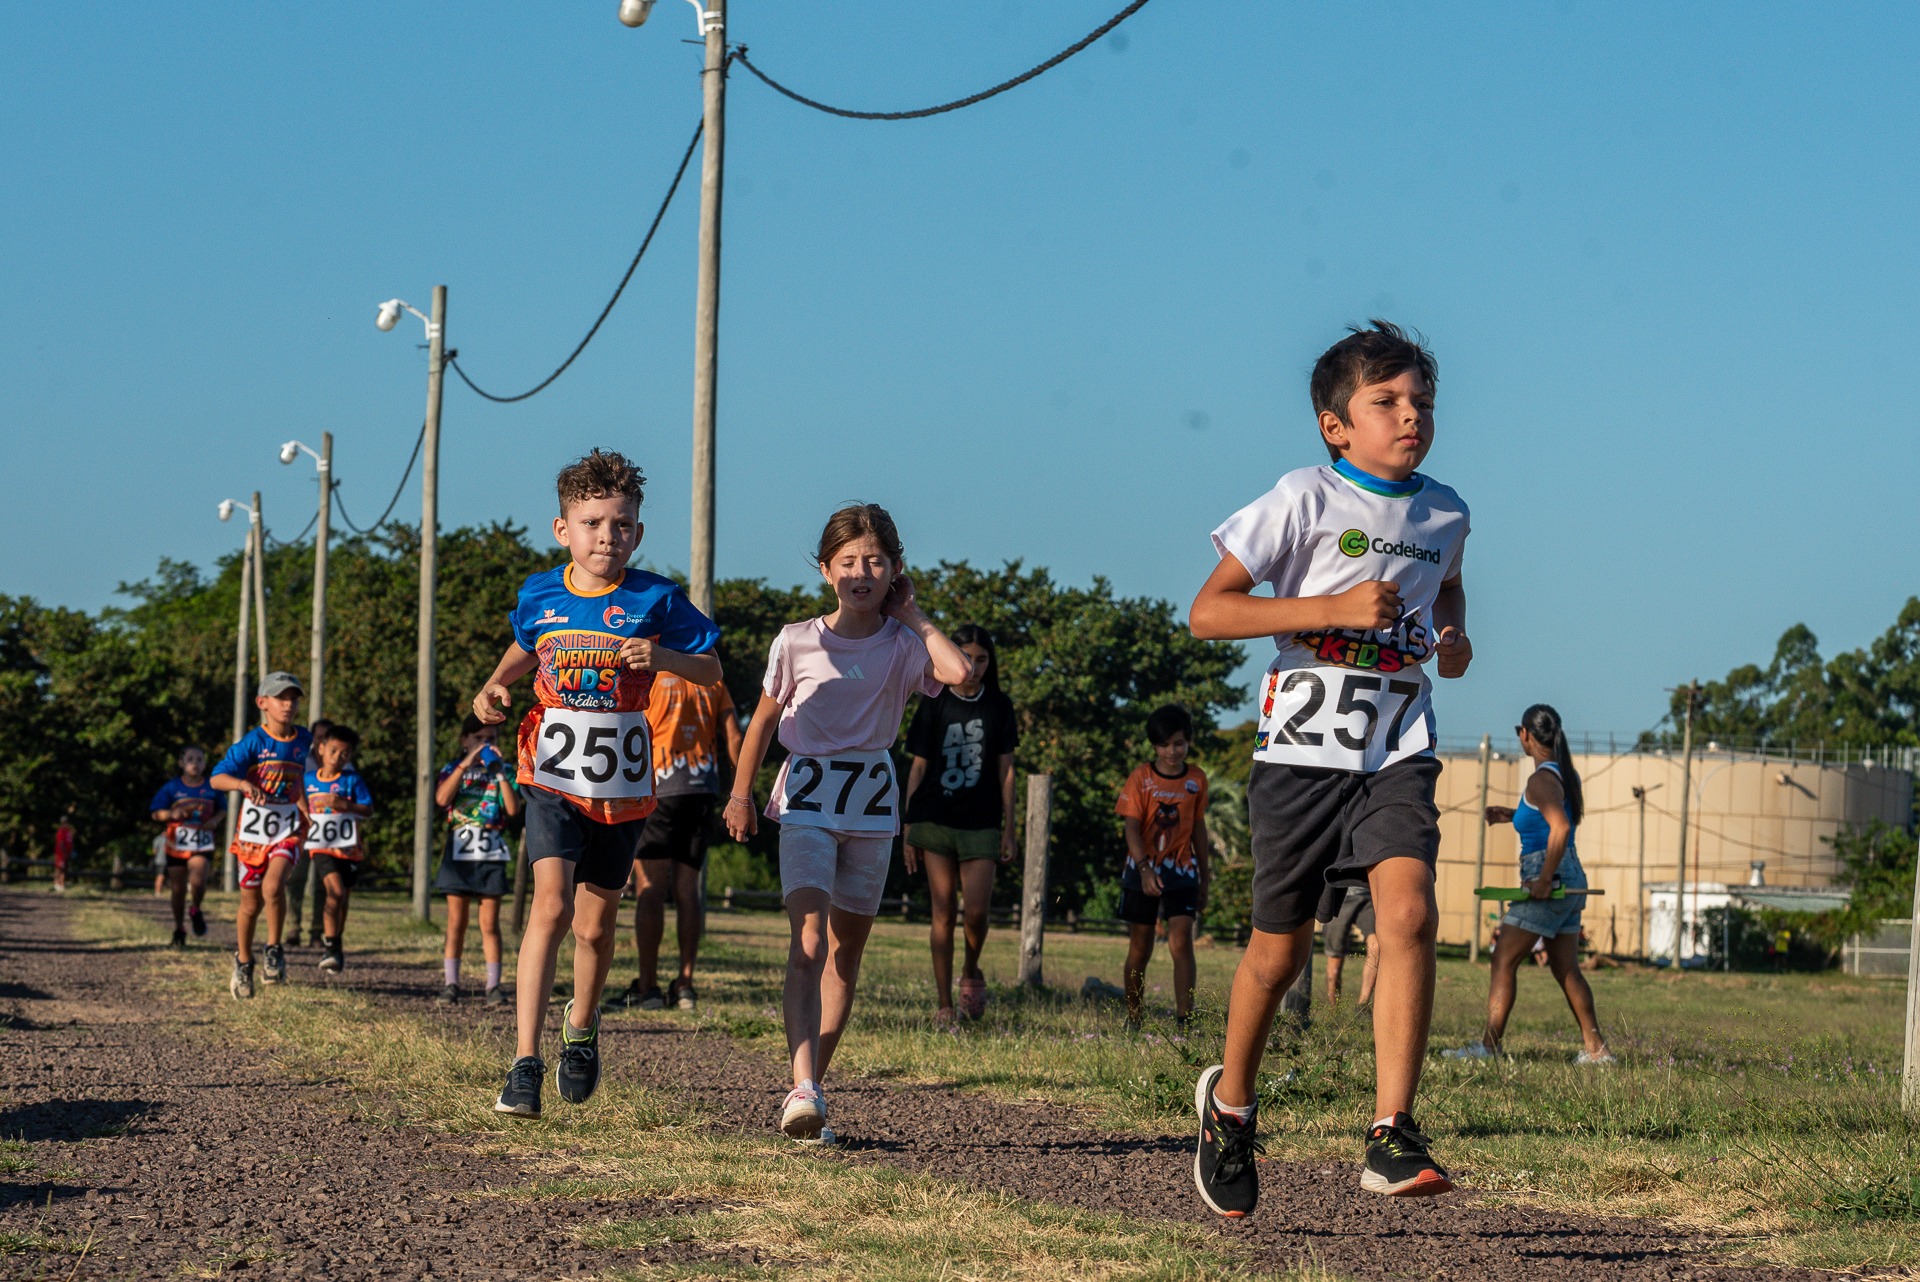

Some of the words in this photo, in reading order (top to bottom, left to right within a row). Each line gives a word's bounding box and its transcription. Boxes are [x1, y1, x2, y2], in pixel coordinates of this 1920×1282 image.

[1372, 537, 1440, 565] Codeland
[553, 648, 621, 670] AVENTURA
[556, 668, 616, 692] KIDS
[1273, 670, 1420, 752] 257
[539, 722, 649, 784] 259
[786, 757, 893, 816] 272
[243, 807, 297, 838] 261
[308, 818, 353, 842] 260
